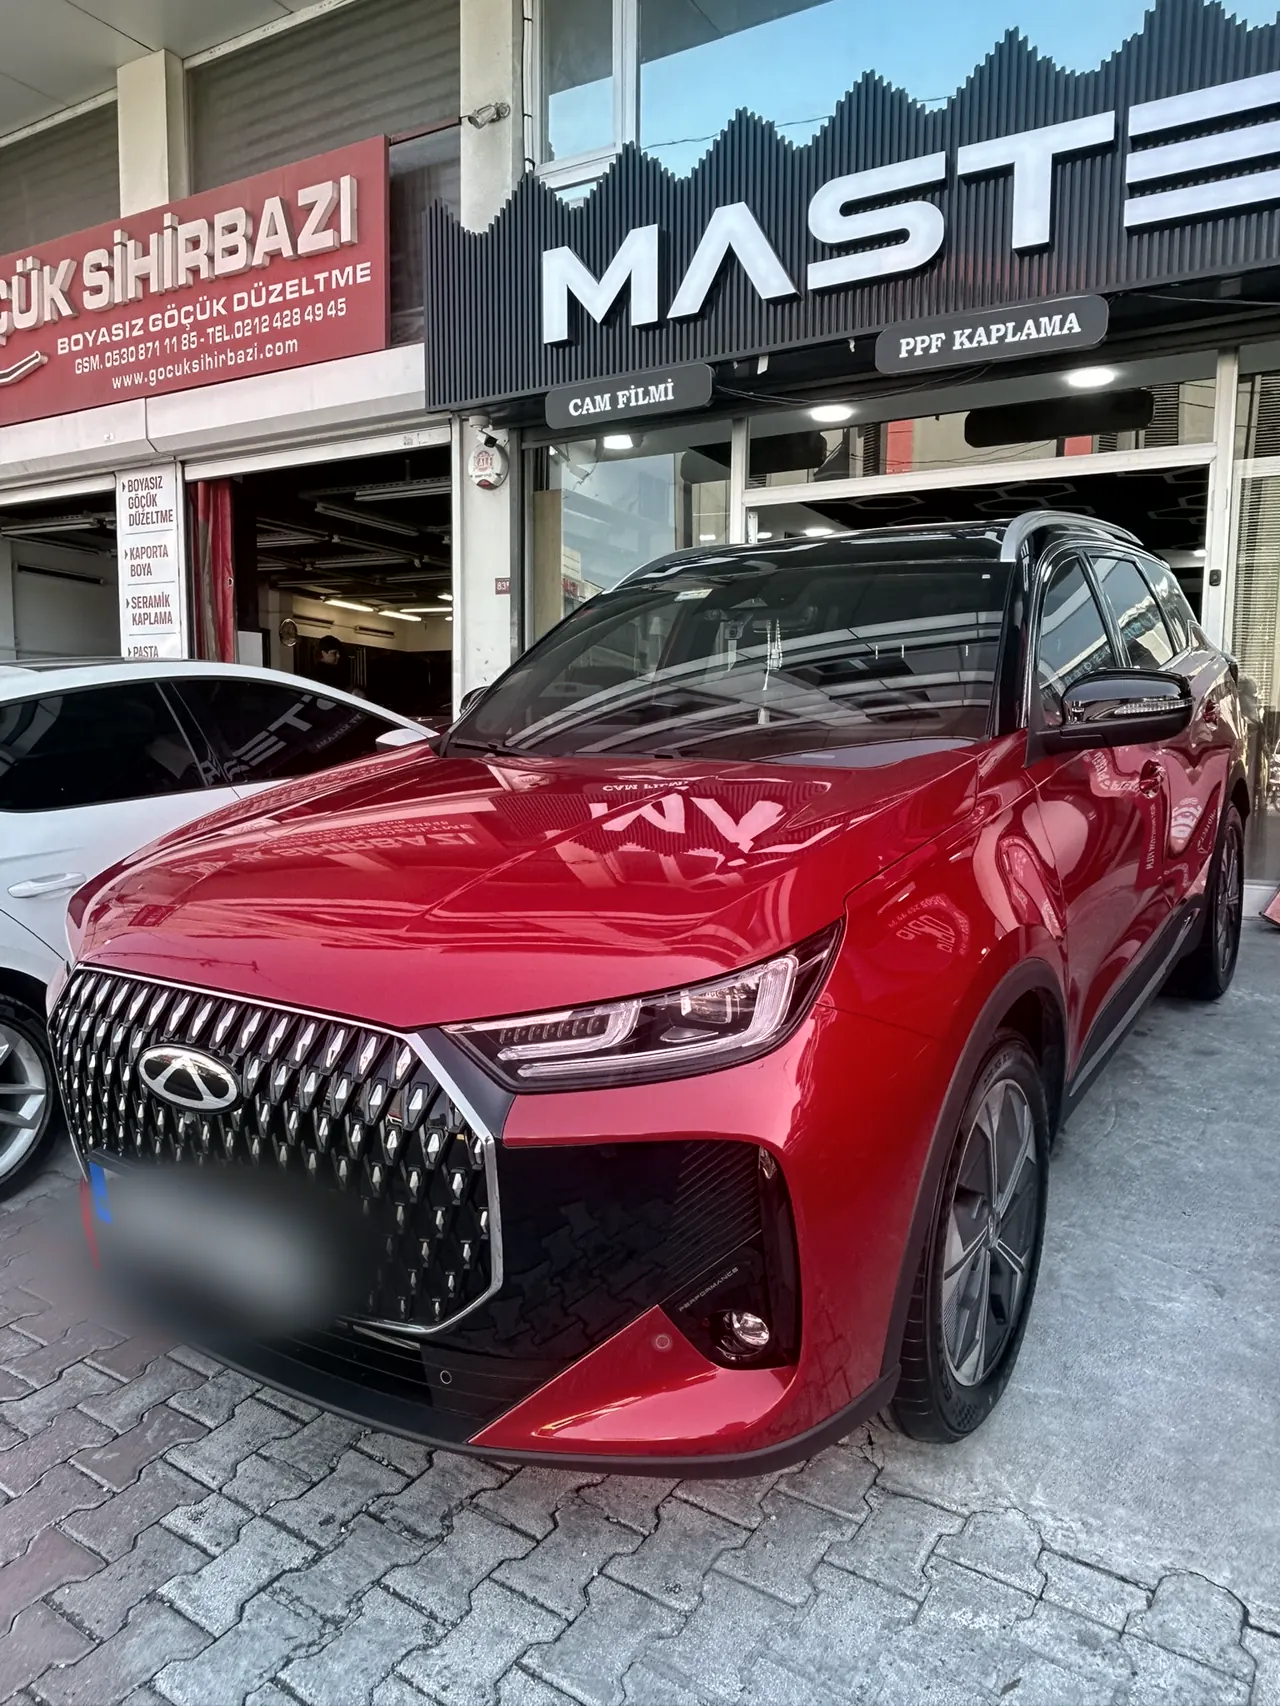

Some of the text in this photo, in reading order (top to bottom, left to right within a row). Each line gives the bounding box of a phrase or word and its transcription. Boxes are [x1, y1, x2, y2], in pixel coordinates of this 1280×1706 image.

[82, 174, 358, 311] SİHİRBAZI
[57, 262, 371, 355] BOYASIZ GÖÇÜK DÜZELTME
[75, 354, 103, 374] GSM.
[105, 346, 136, 368] 0530
[138, 341, 160, 360] 871
[164, 336, 177, 355] 11
[181, 332, 198, 350] 85
[272, 307, 301, 330] 428
[304, 302, 324, 323] 49
[327, 297, 347, 318] 45
[899, 312, 1082, 359] PPF KAPLAMA
[112, 338, 298, 389] www.gocuksihirbazi.com
[568, 378, 675, 416] CAM FİLMİ
[127, 475, 163, 493] BOYASIZ
[128, 492, 158, 510] GÖÇÜK
[128, 508, 174, 527] DÜZELTME
[129, 544, 169, 561] KAPORTA
[130, 562, 153, 577] BOYA
[131, 591, 171, 609] SERAMİK
[132, 610, 173, 626] KAPLAMA
[133, 645, 159, 658] PASTA
[679, 1266, 739, 1312] PERFORMANCE
